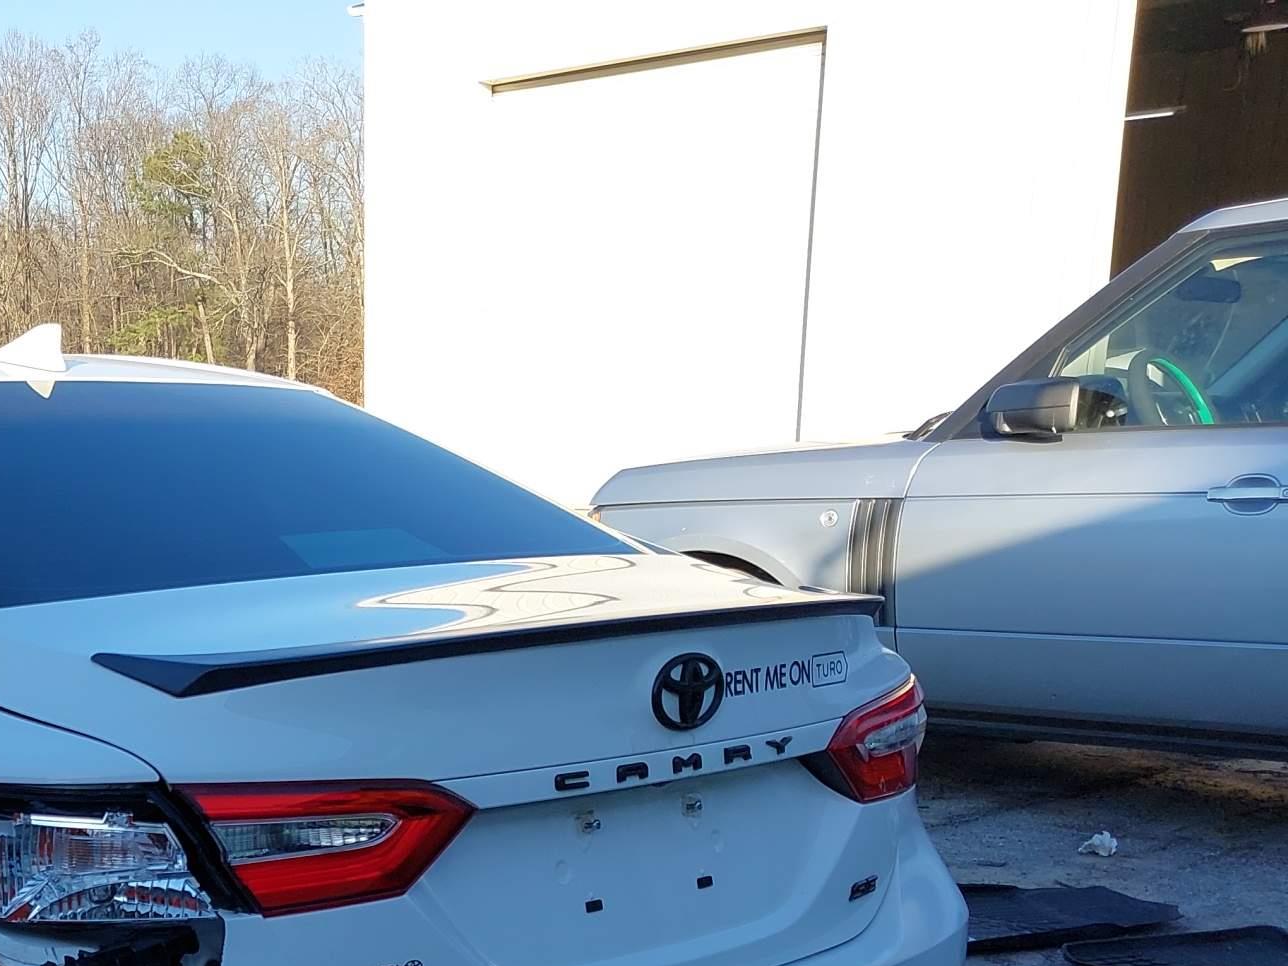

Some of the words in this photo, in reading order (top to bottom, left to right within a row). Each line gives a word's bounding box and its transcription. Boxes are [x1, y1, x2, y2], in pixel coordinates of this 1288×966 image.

[725, 667, 761, 697] RENT
[765, 663, 787, 691] ME
[789, 660, 811, 686] ON
[816, 659, 843, 679] TURO
[554, 736, 793, 792] CAMRY
